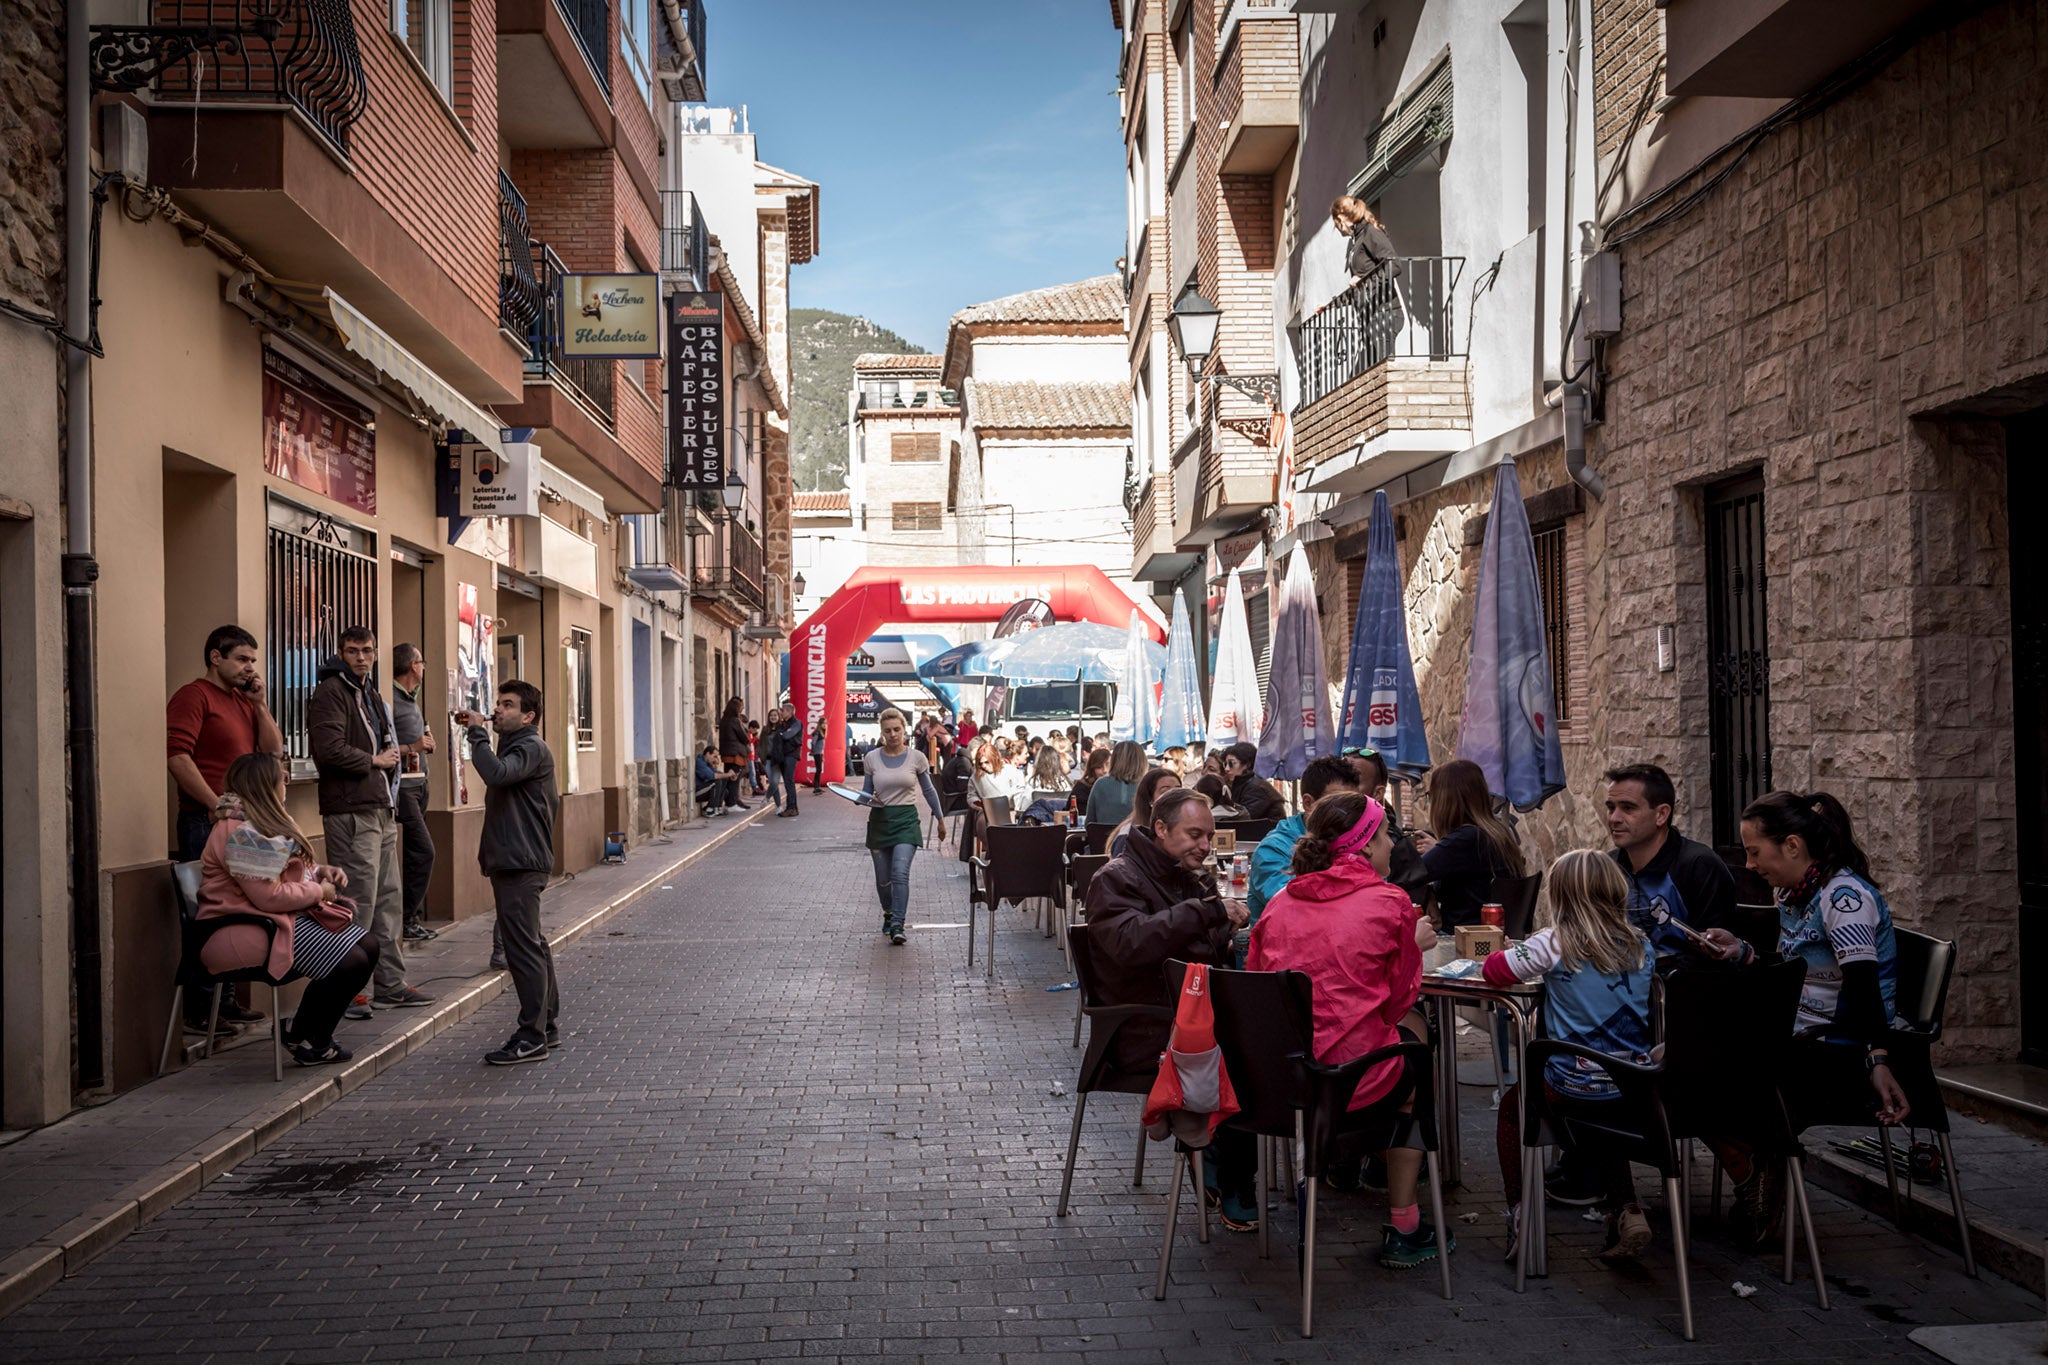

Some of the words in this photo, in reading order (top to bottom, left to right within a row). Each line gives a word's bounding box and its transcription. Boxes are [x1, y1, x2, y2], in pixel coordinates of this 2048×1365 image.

[575, 327, 649, 343] Heladería
[700, 327, 718, 362] BAR
[700, 368, 719, 403] LOS
[681, 327, 699, 483] CAFETERIA
[702, 410, 719, 483] LUISES
[473, 494, 504, 503] Apuestas
[506, 493, 517, 501] del
[900, 586, 936, 605] LAS
[938, 584, 1052, 605] PROVINCIAS
